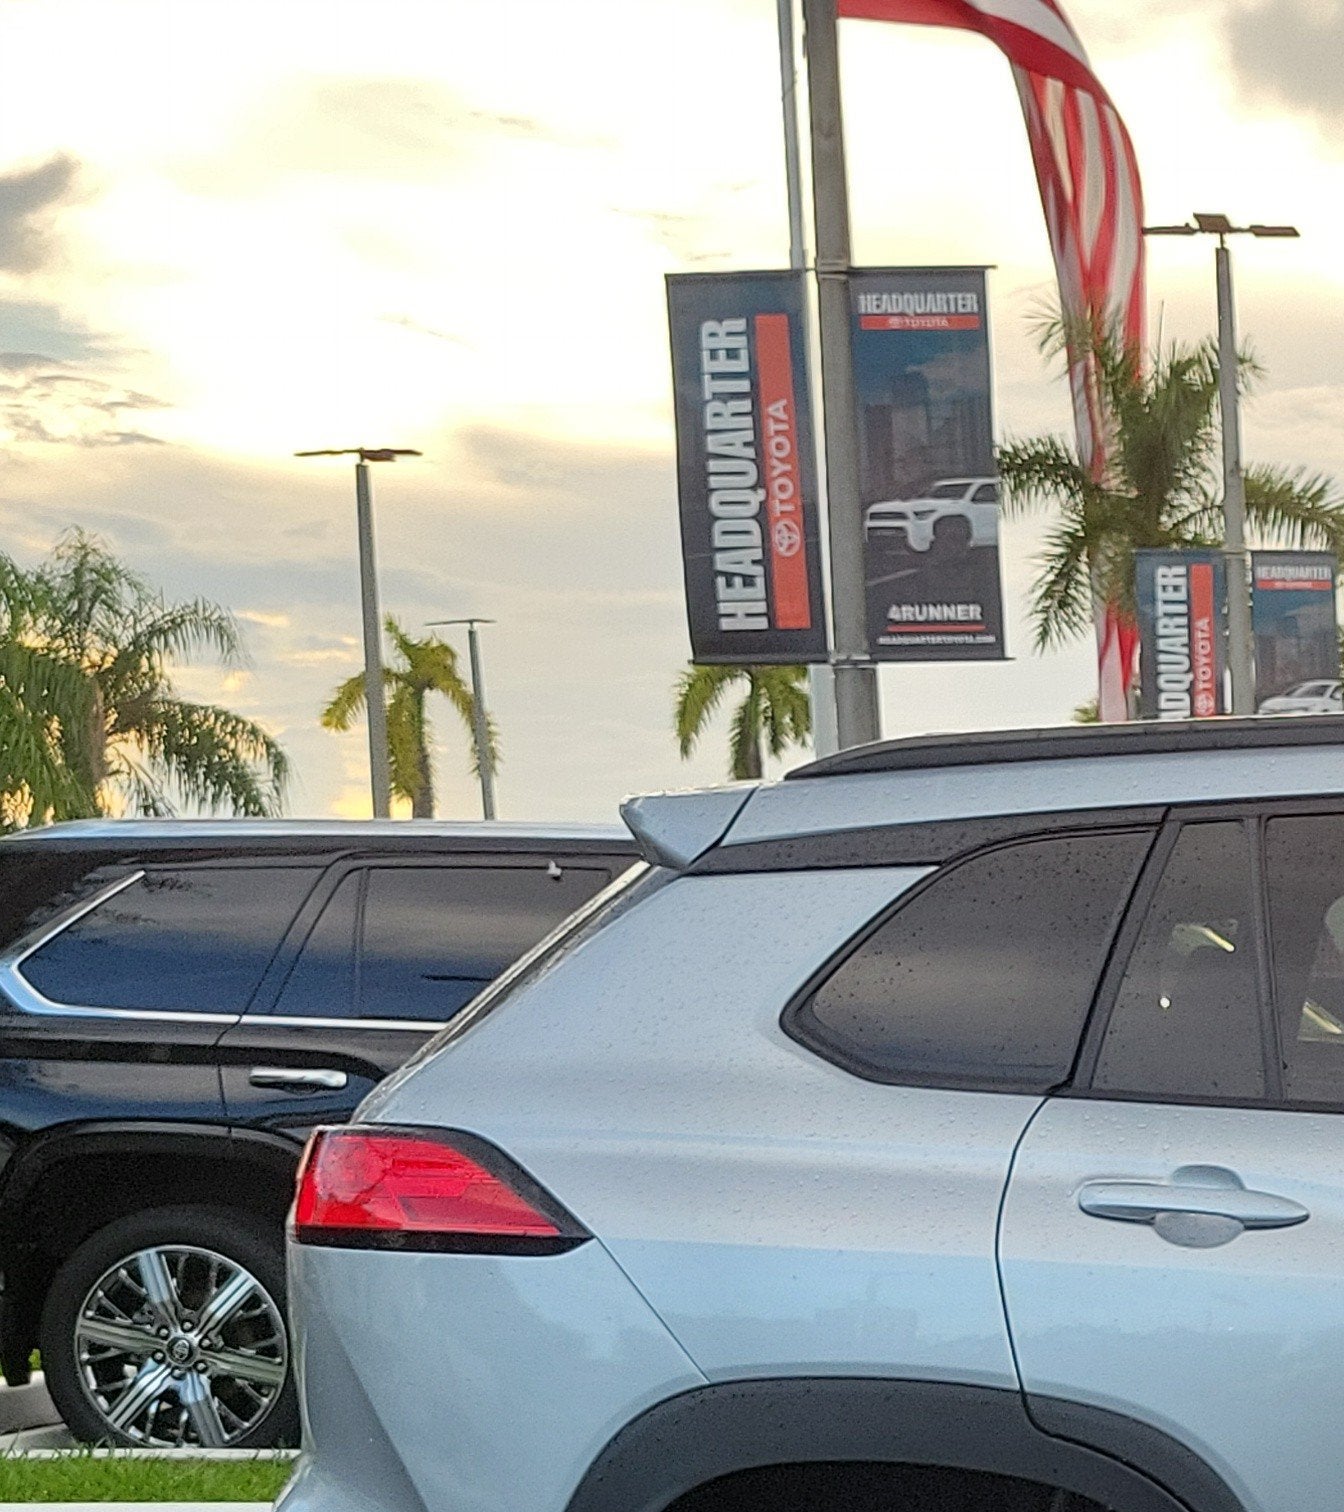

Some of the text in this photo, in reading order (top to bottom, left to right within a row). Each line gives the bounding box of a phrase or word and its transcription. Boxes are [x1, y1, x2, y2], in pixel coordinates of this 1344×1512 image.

[858, 292, 978, 315] HEADQUARTER
[701, 317, 769, 632] HEADQUARTER
[766, 399, 796, 517] TOYOTA
[887, 603, 982, 621] 4RUNNER
[1155, 564, 1193, 719] DQUARTER
[1195, 618, 1212, 690] TOYOTA
